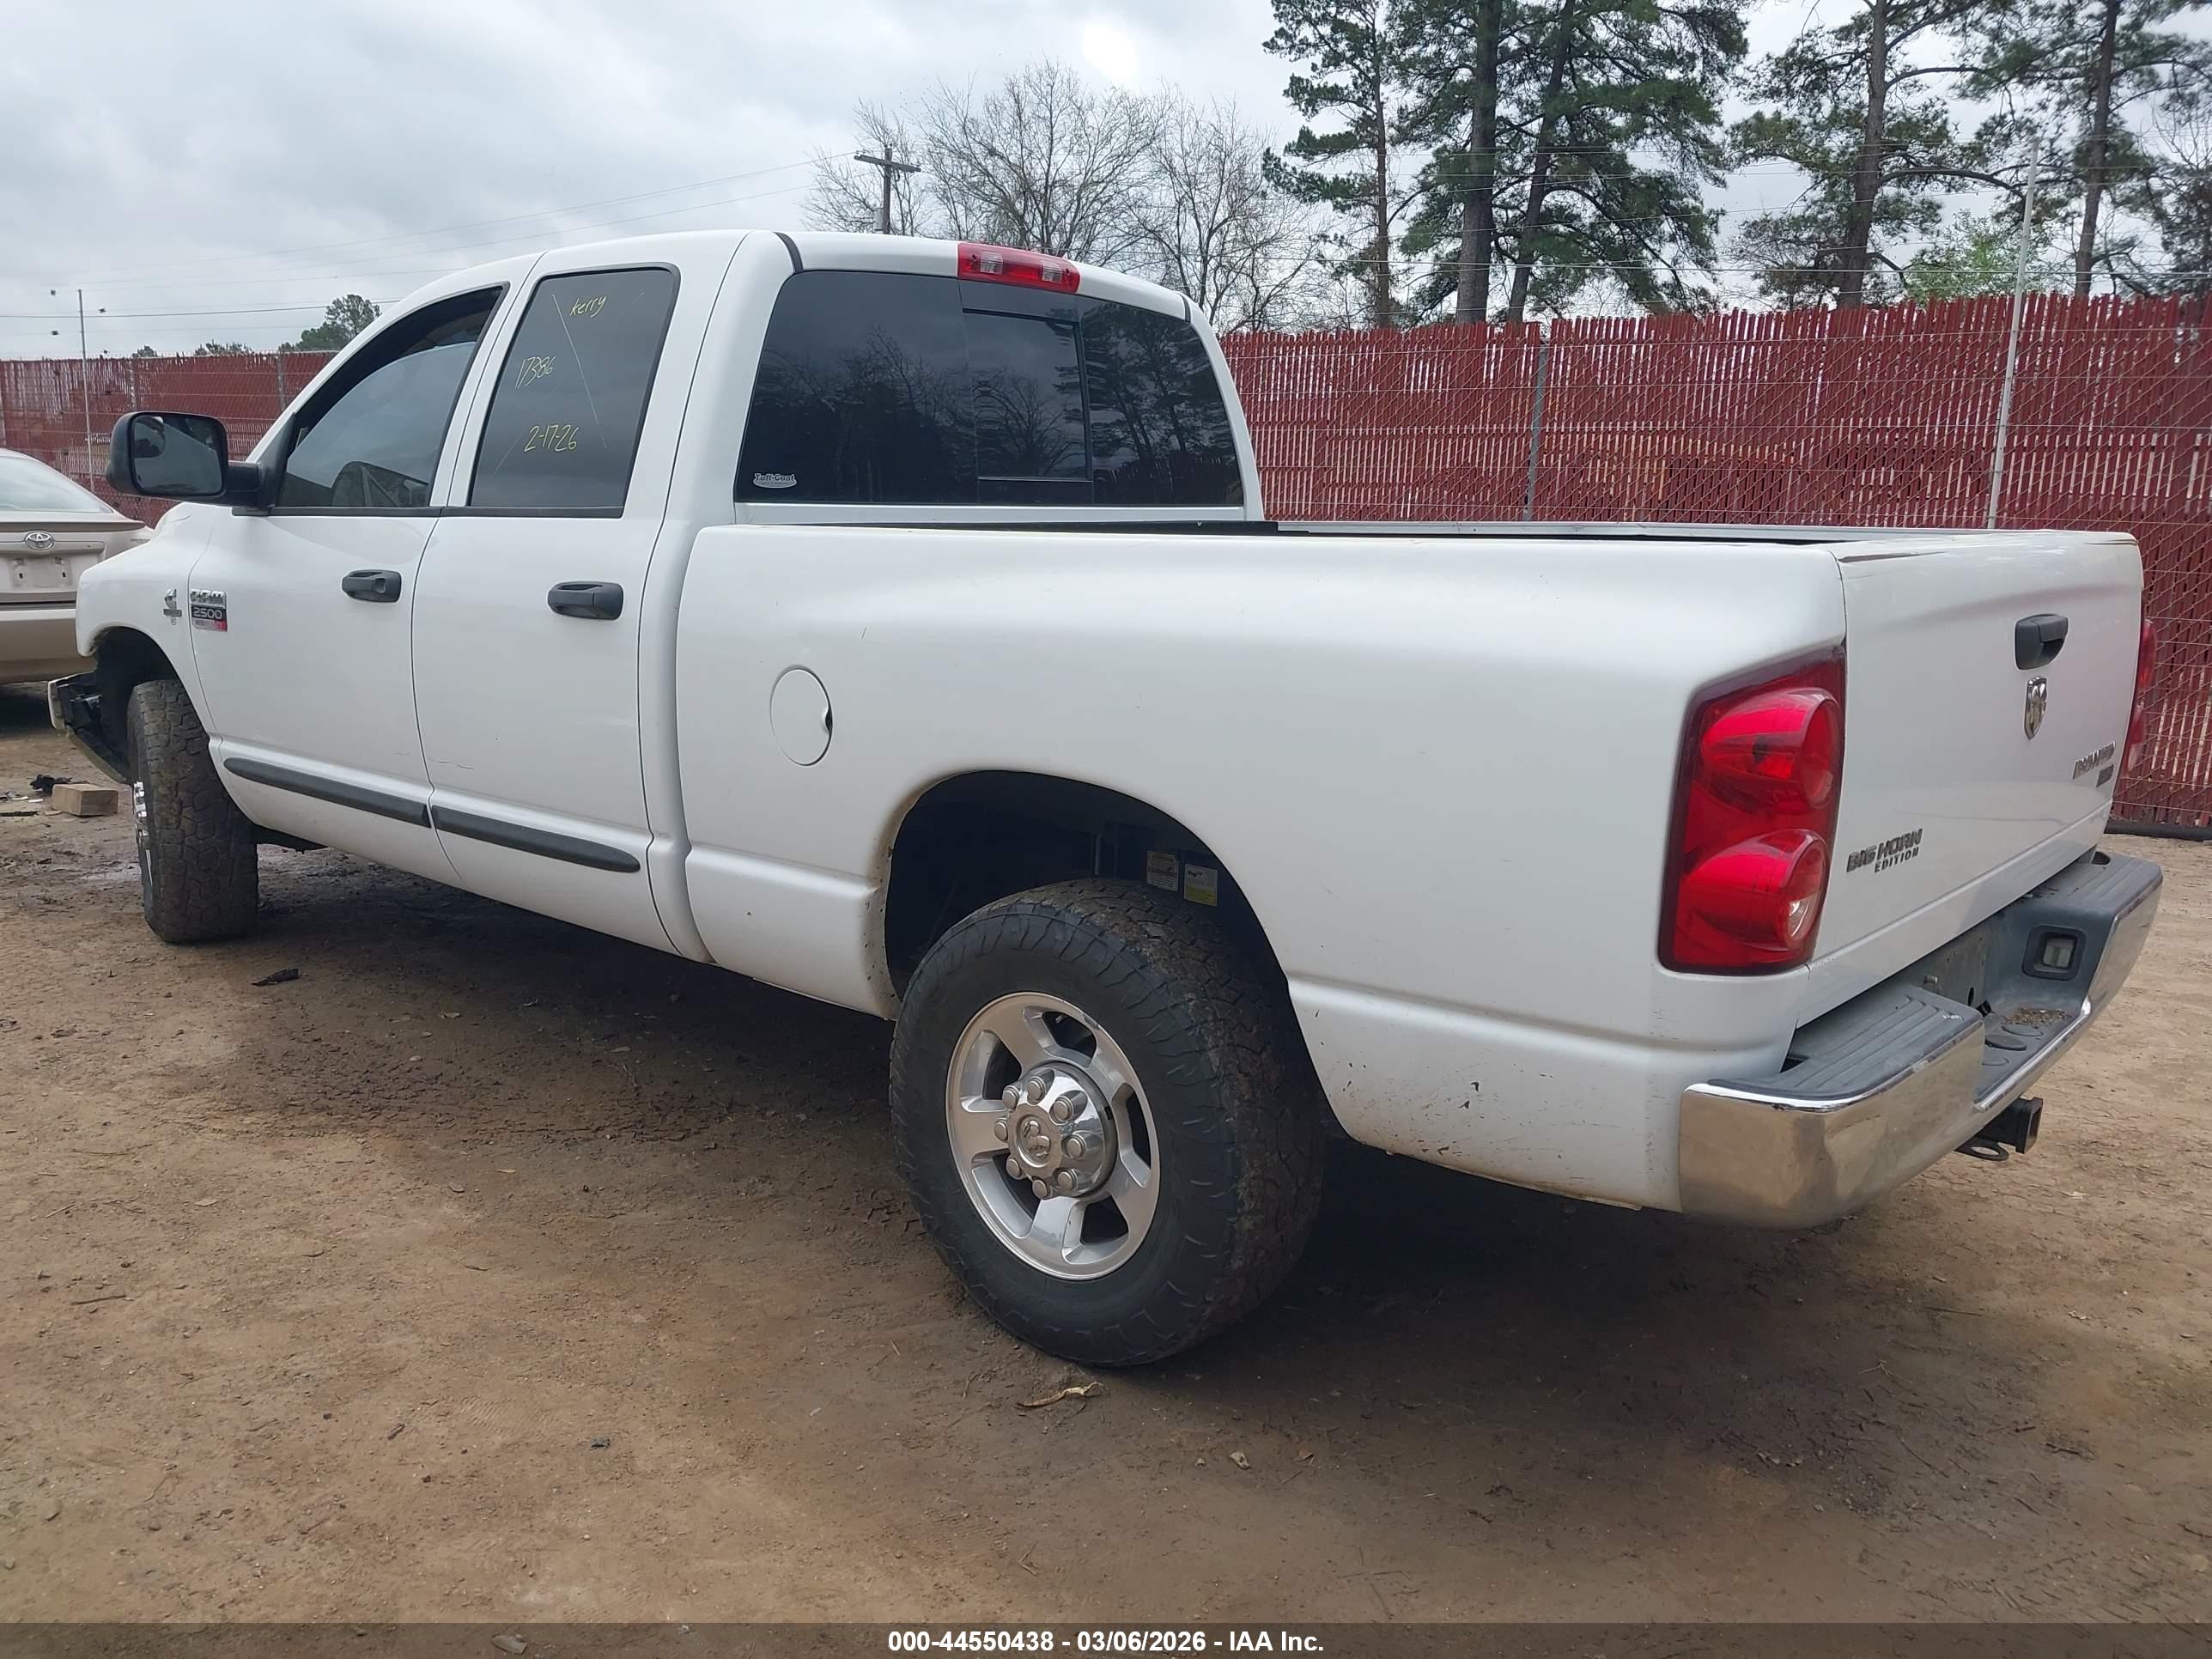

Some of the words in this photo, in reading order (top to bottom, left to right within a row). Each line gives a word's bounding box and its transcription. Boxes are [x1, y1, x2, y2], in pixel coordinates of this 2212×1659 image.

[523, 424, 581, 453] 2-17-26
[192, 606, 222, 619] 2500
[1846, 845, 1877, 872] BIG
[1877, 828, 1923, 860] HORN
[1875, 846, 1920, 873] EDITION
